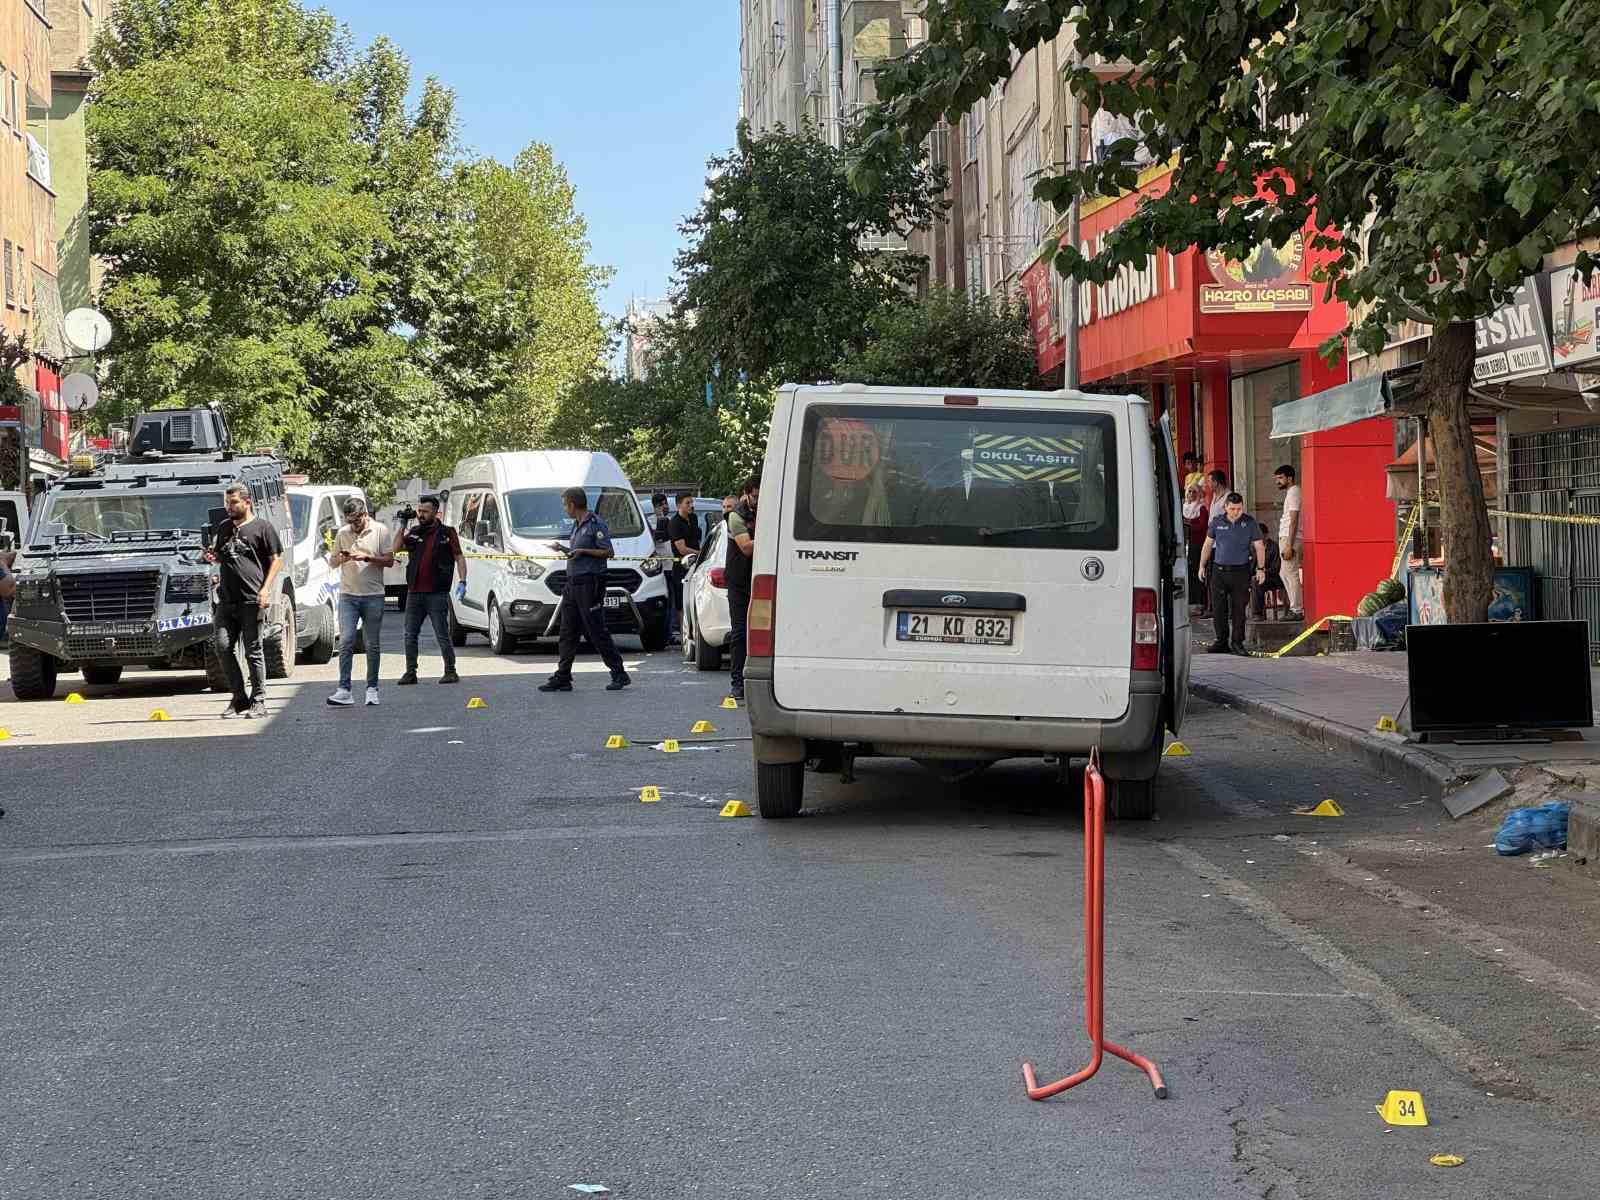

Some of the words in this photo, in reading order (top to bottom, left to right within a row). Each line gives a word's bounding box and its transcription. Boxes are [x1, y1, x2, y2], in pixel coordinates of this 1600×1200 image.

[1204, 290, 1253, 302] HAZRO
[1256, 288, 1309, 302] KASABI
[980, 451, 1022, 461] OKUL
[796, 550, 859, 561] TRANSIT
[161, 619, 174, 631] 21
[177, 615, 186, 628] A
[911, 615, 929, 634] 21
[943, 616, 964, 636] KD
[974, 619, 1005, 638] 832
[1398, 1100, 1416, 1117] 34
